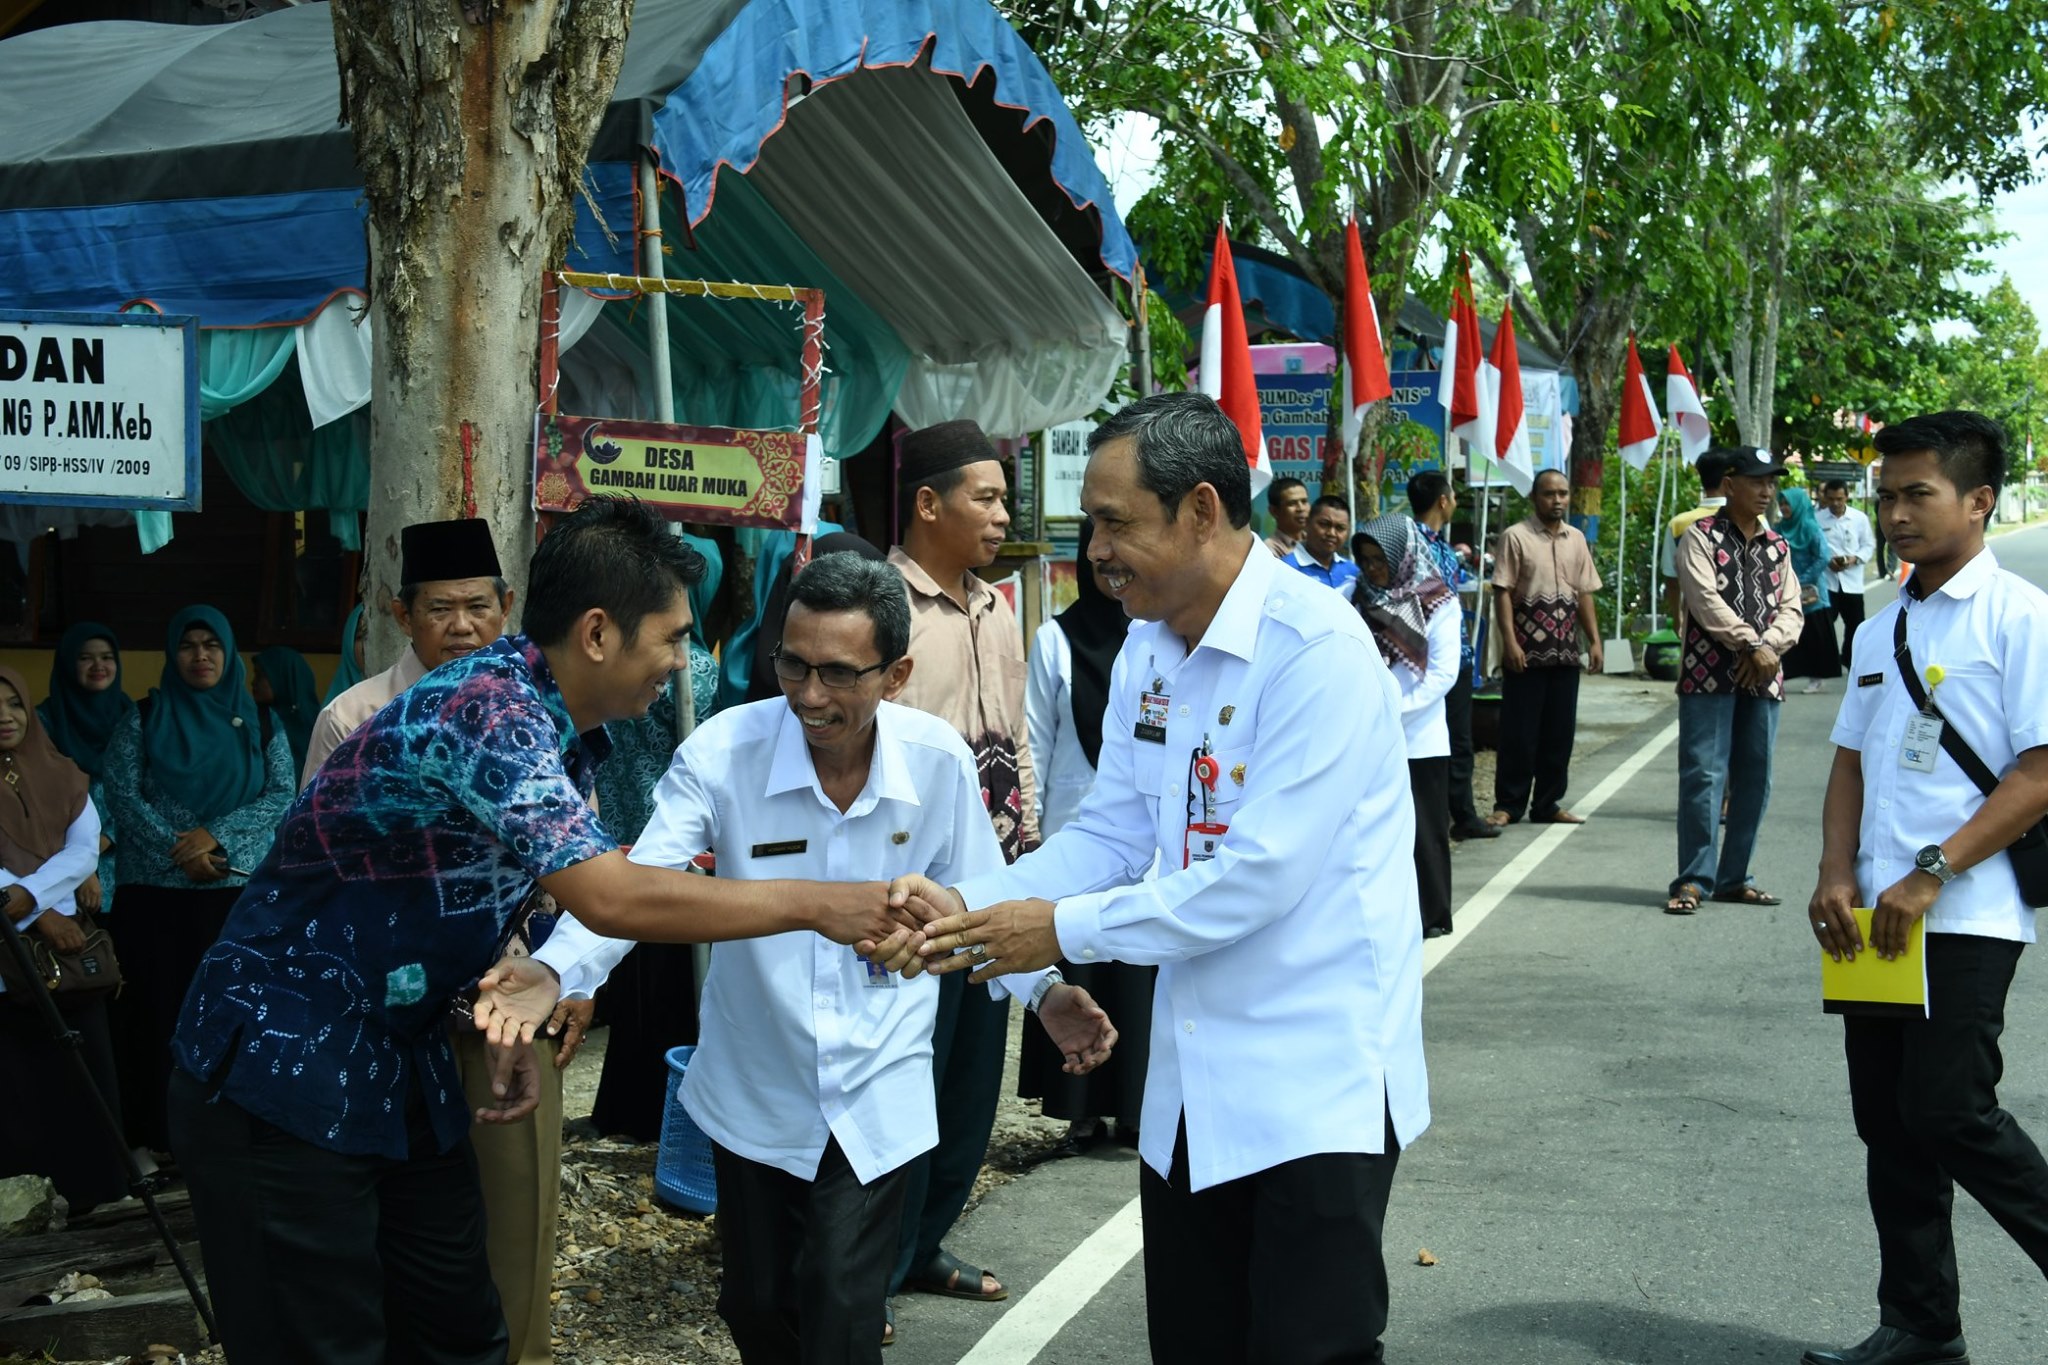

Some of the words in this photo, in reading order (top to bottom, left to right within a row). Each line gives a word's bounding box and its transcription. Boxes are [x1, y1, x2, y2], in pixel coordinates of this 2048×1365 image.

[0, 335, 105, 385] DAN
[0, 398, 32, 437] NG
[645, 446, 694, 471] DESA
[590, 468, 655, 490] GAMBAH
[659, 473, 698, 493] LUAR
[701, 477, 748, 498] MUKA
